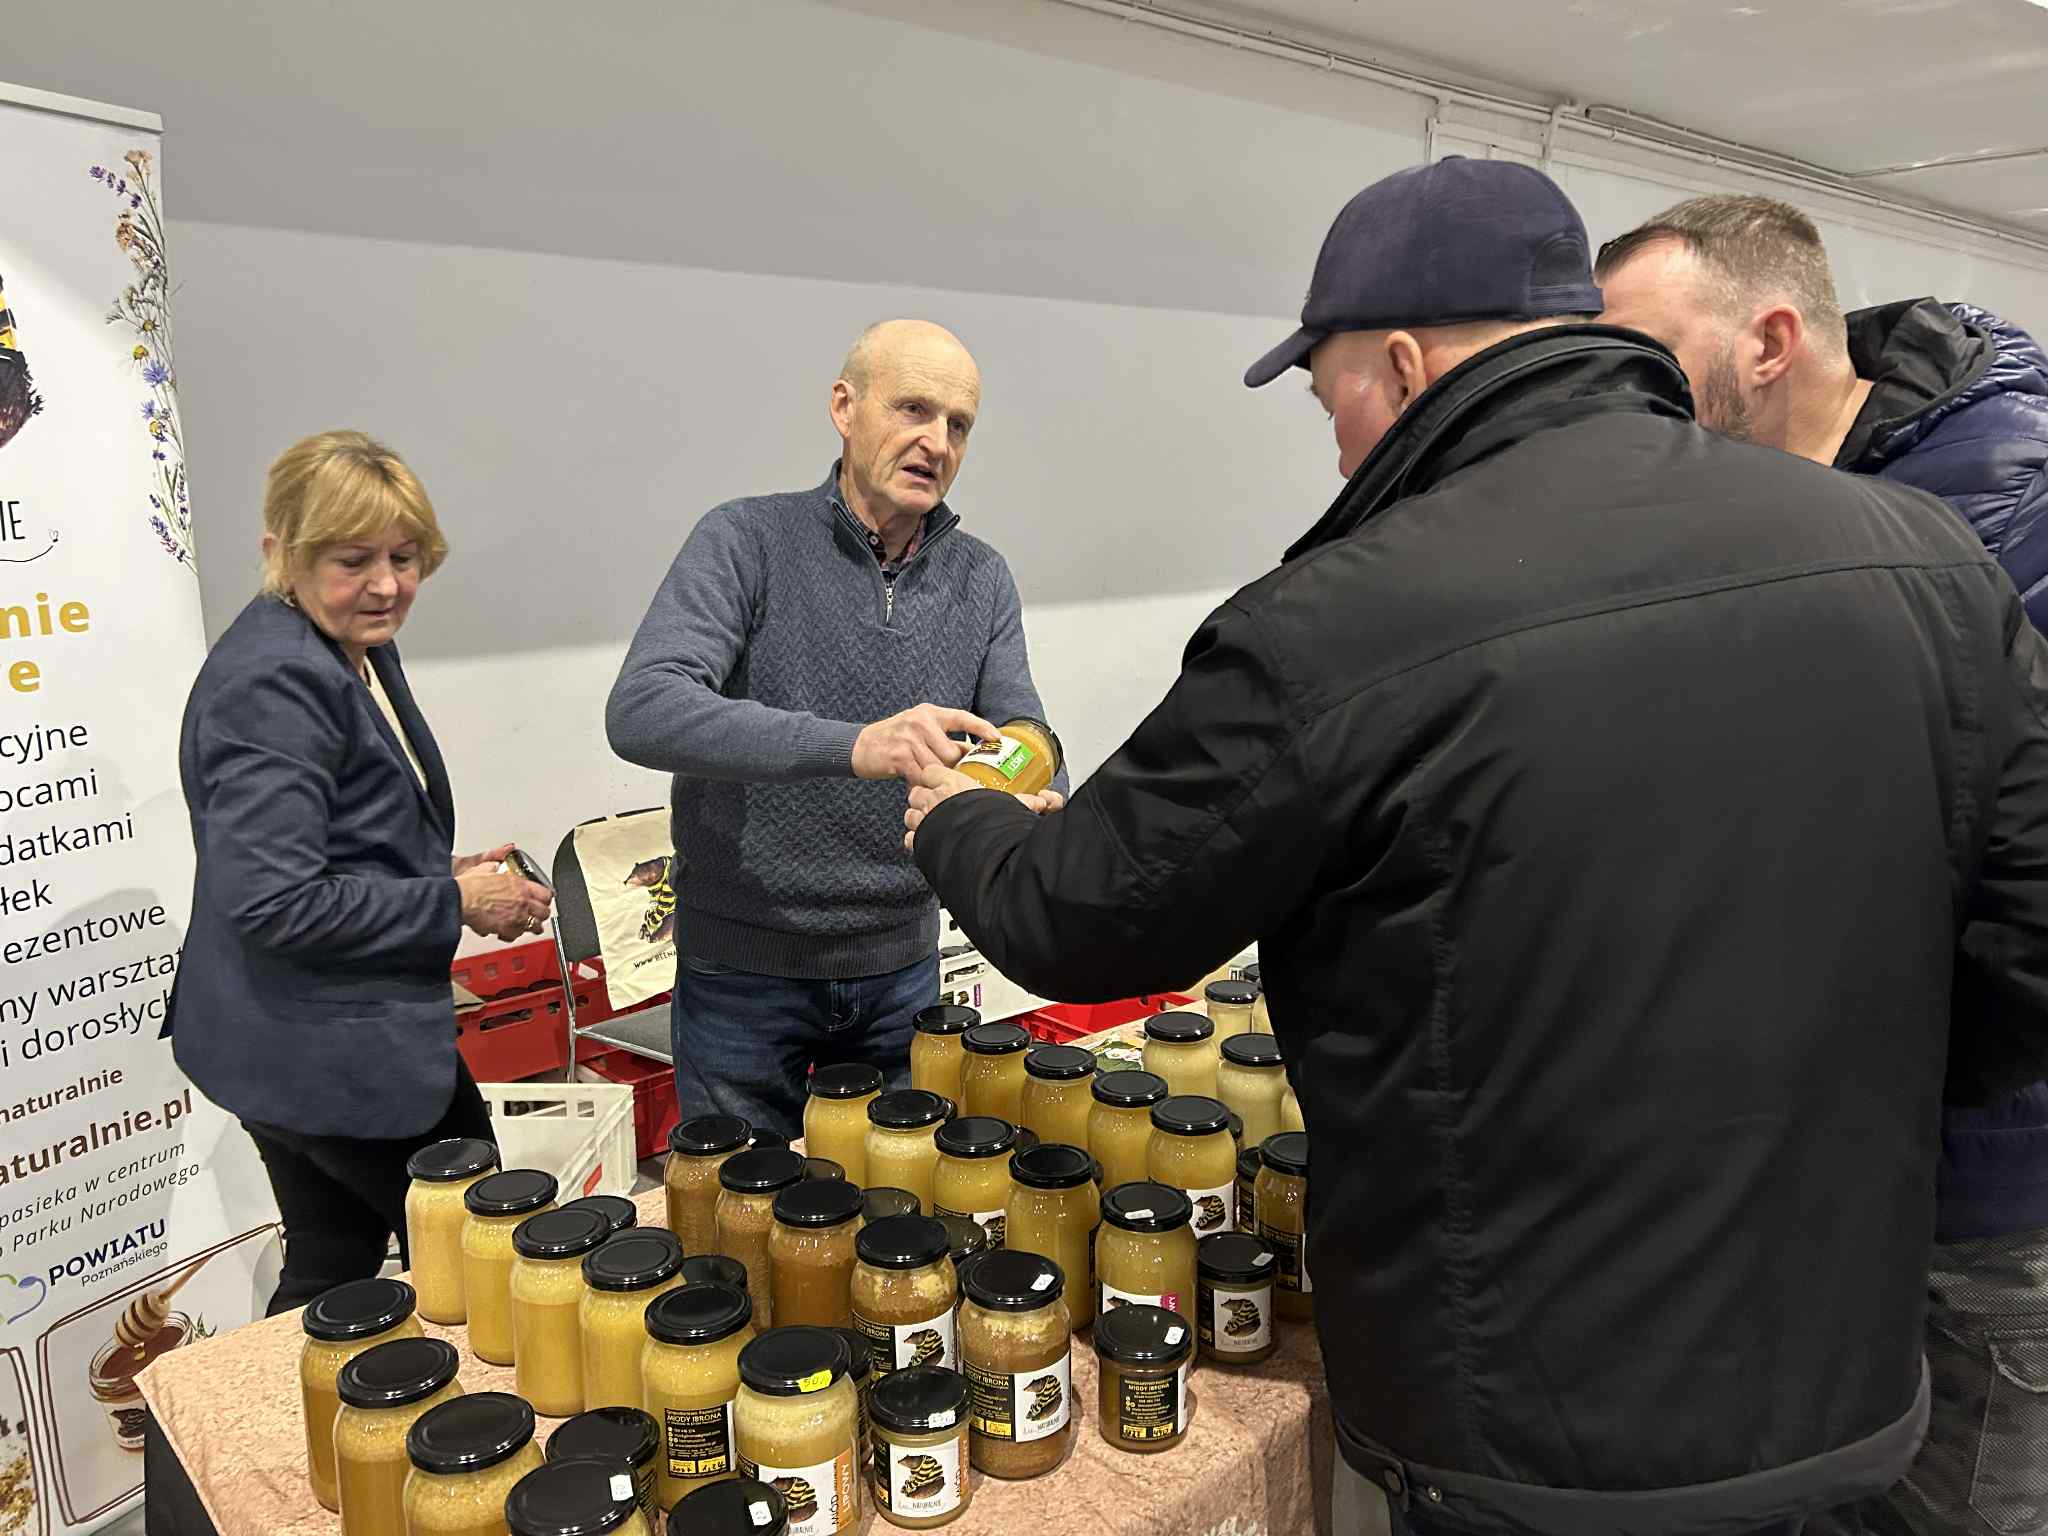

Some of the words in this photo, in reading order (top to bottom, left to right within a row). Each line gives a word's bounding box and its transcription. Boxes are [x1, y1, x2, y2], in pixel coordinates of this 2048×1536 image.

[0, 592, 89, 639] nie
[0, 725, 88, 764] cyjne
[0, 768, 98, 812] ocami
[0, 812, 133, 866] datkami
[0, 879, 53, 915] łek
[4, 905, 166, 964] ezentowe
[0, 1069, 123, 1124] naturalnie
[0, 1089, 192, 1187] aturalnie.pl
[0, 1186, 77, 1231] pasieka
[85, 1177, 99, 1194] w
[108, 1143, 185, 1184] centrum
[13, 1216, 71, 1252] Parku
[81, 1163, 199, 1223] Narodowego
[49, 1218, 166, 1287] POWIATU
[82, 1241, 168, 1287] Poznańskiego
